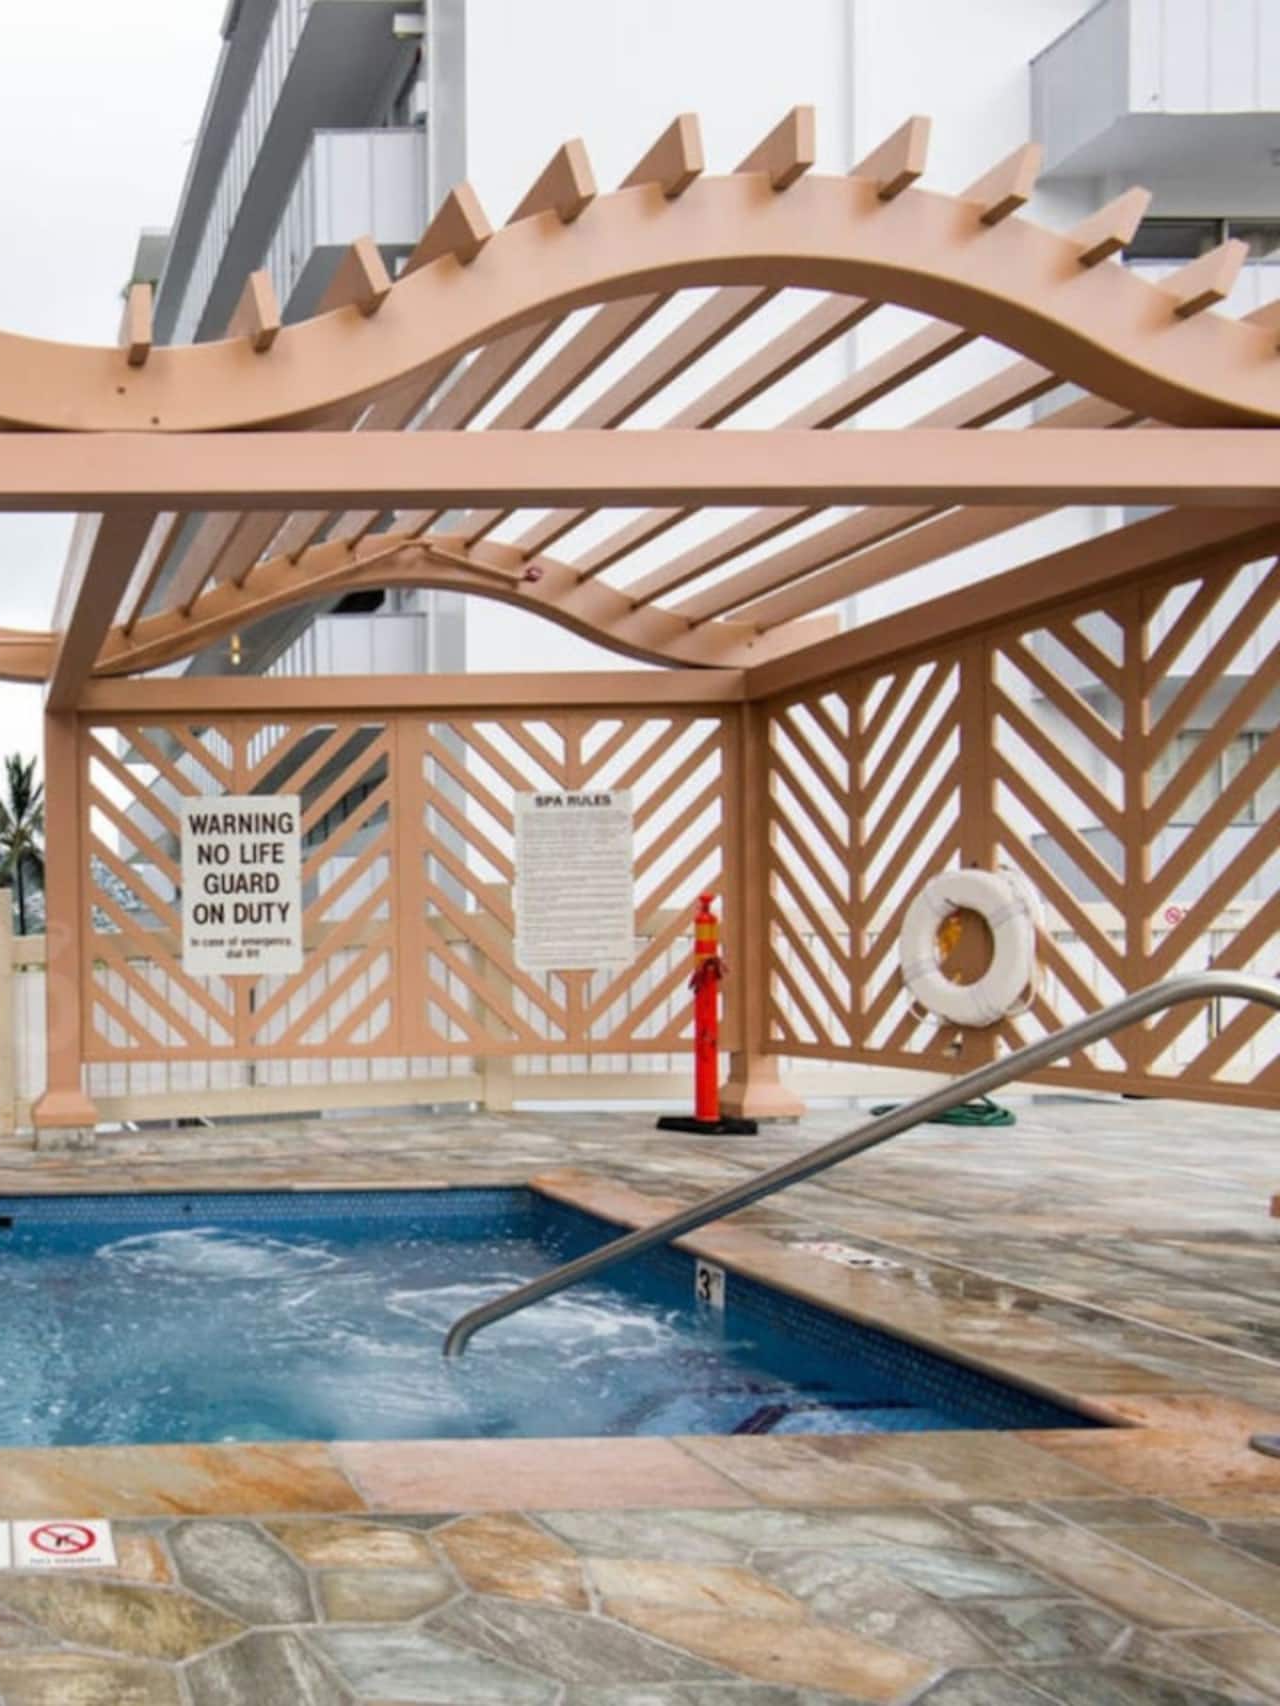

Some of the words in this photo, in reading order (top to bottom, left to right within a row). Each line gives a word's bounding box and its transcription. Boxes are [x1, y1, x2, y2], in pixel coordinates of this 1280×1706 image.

[536, 796, 562, 808] SPA
[567, 795, 611, 808] RULES
[189, 813, 294, 835] WARNING
[197, 844, 230, 865] NO
[240, 843, 285, 864] LIFE
[203, 872, 280, 895] GUARD
[193, 903, 224, 925] ON
[234, 902, 290, 924] DUTY
[699, 1268, 711, 1301] 3
